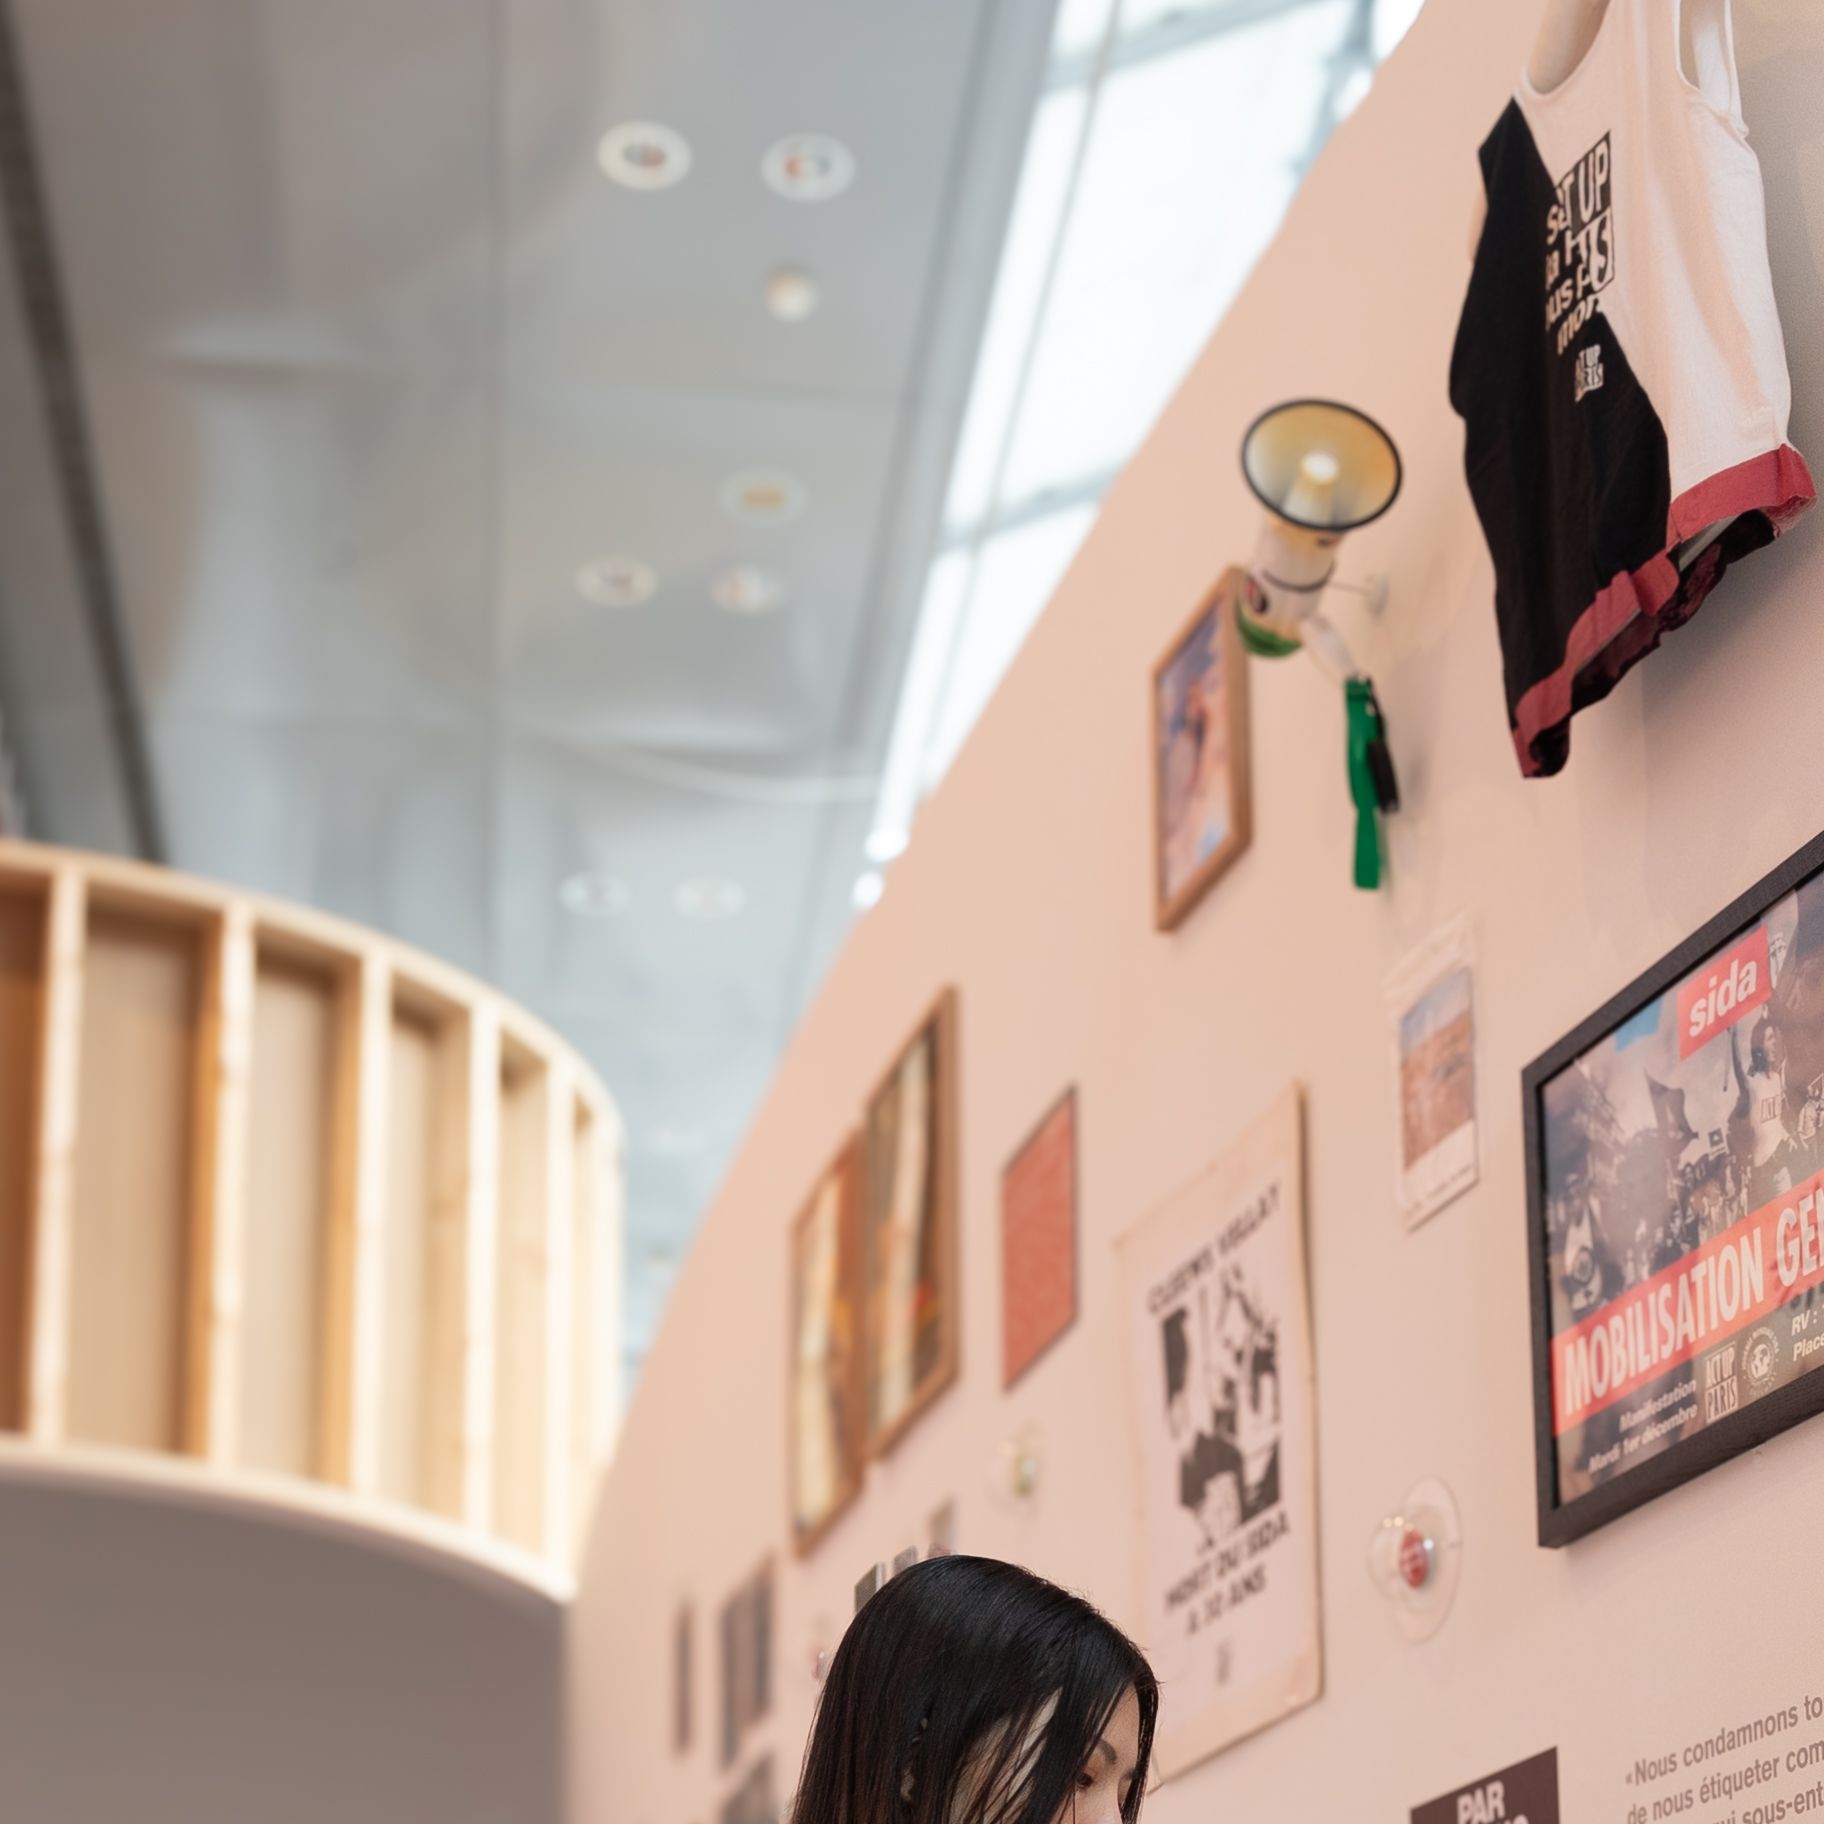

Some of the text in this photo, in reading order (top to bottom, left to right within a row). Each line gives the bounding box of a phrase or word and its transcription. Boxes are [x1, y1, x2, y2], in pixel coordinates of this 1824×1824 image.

[1688, 957, 1758, 1038] sida
[1563, 1227, 1765, 1417] MOBILISATION
[1791, 1308, 1811, 1336] RV
[1705, 1352, 1722, 1387] ACT
[1619, 1378, 1697, 1434] Manifestation
[1641, 1404, 1698, 1448] décembre
[1704, 1379, 1738, 1424] PARIS
[1682, 1705, 1799, 1768] condamnons
[1652, 1788, 1694, 1821] nous
[1699, 1756, 1780, 1804] étiqueter
